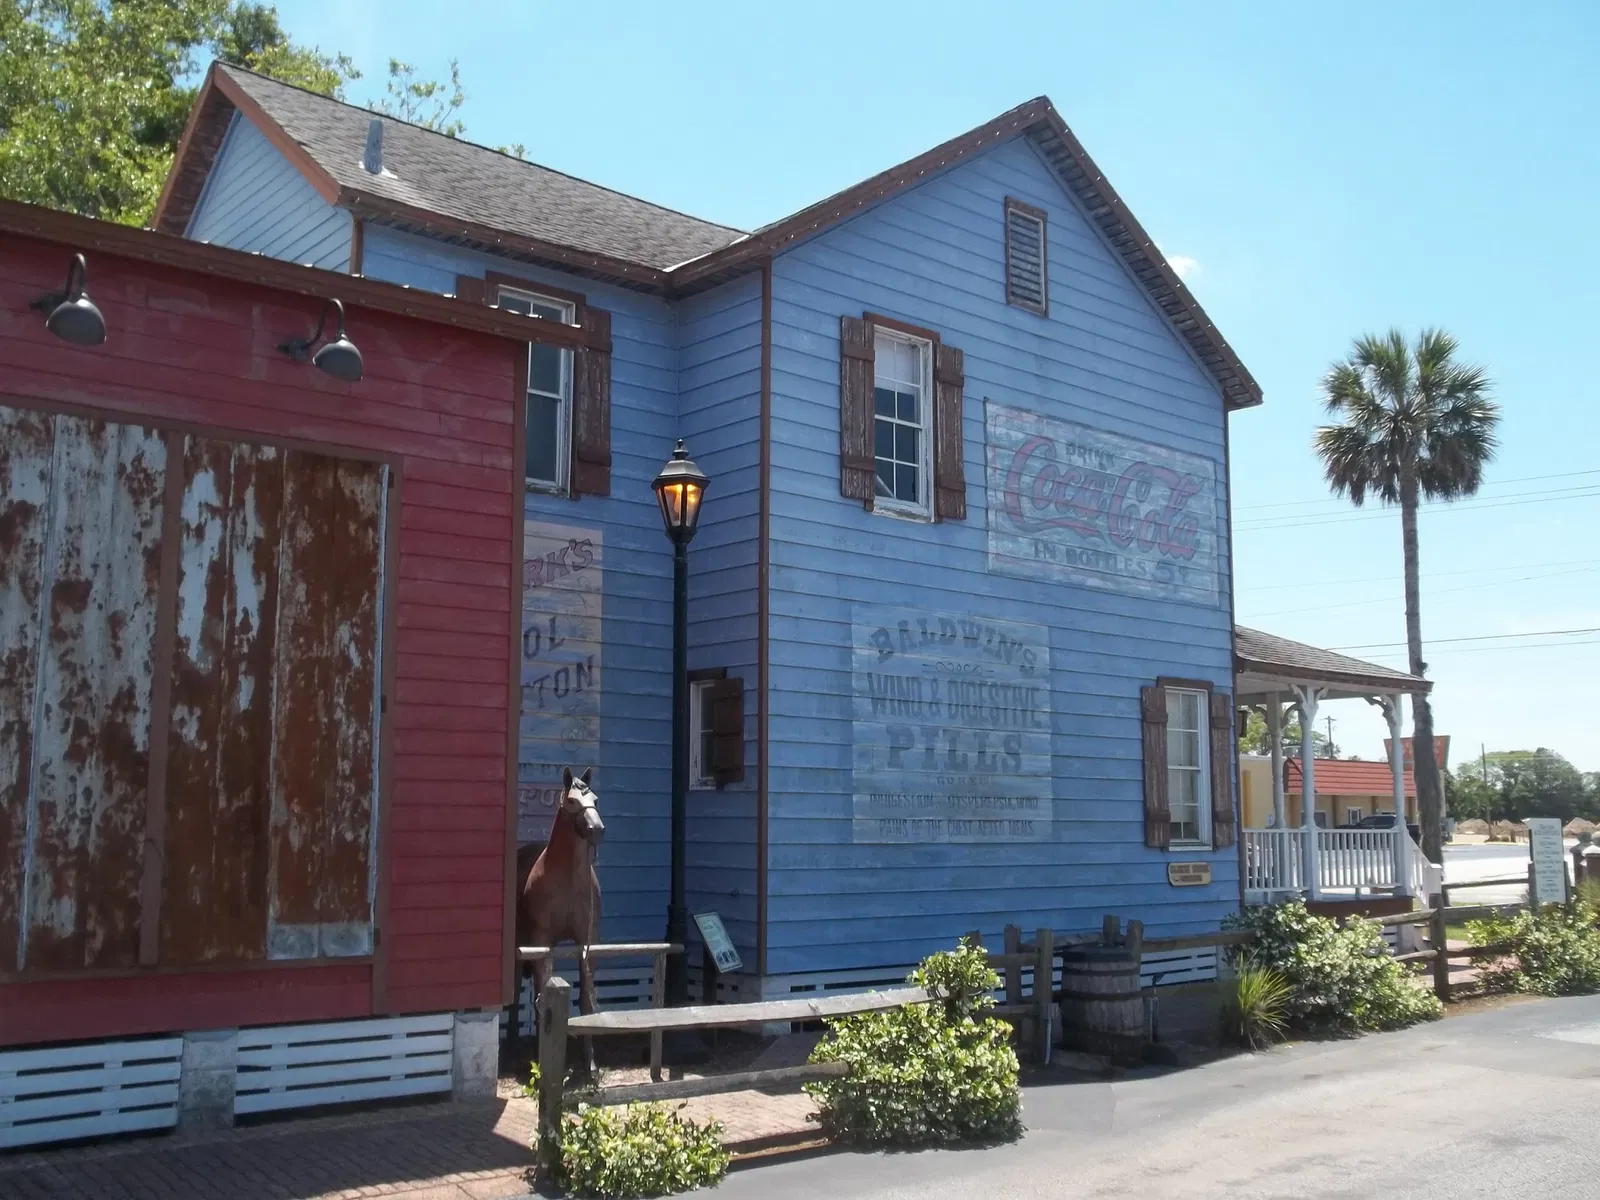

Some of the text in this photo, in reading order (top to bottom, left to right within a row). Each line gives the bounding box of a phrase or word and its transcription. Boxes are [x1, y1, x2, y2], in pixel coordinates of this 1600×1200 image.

[521, 655, 594, 712] TON
[867, 671, 923, 718] WIND
[947, 680, 1043, 730] DIGESTIVE
[886, 724, 1023, 773] PILLS
